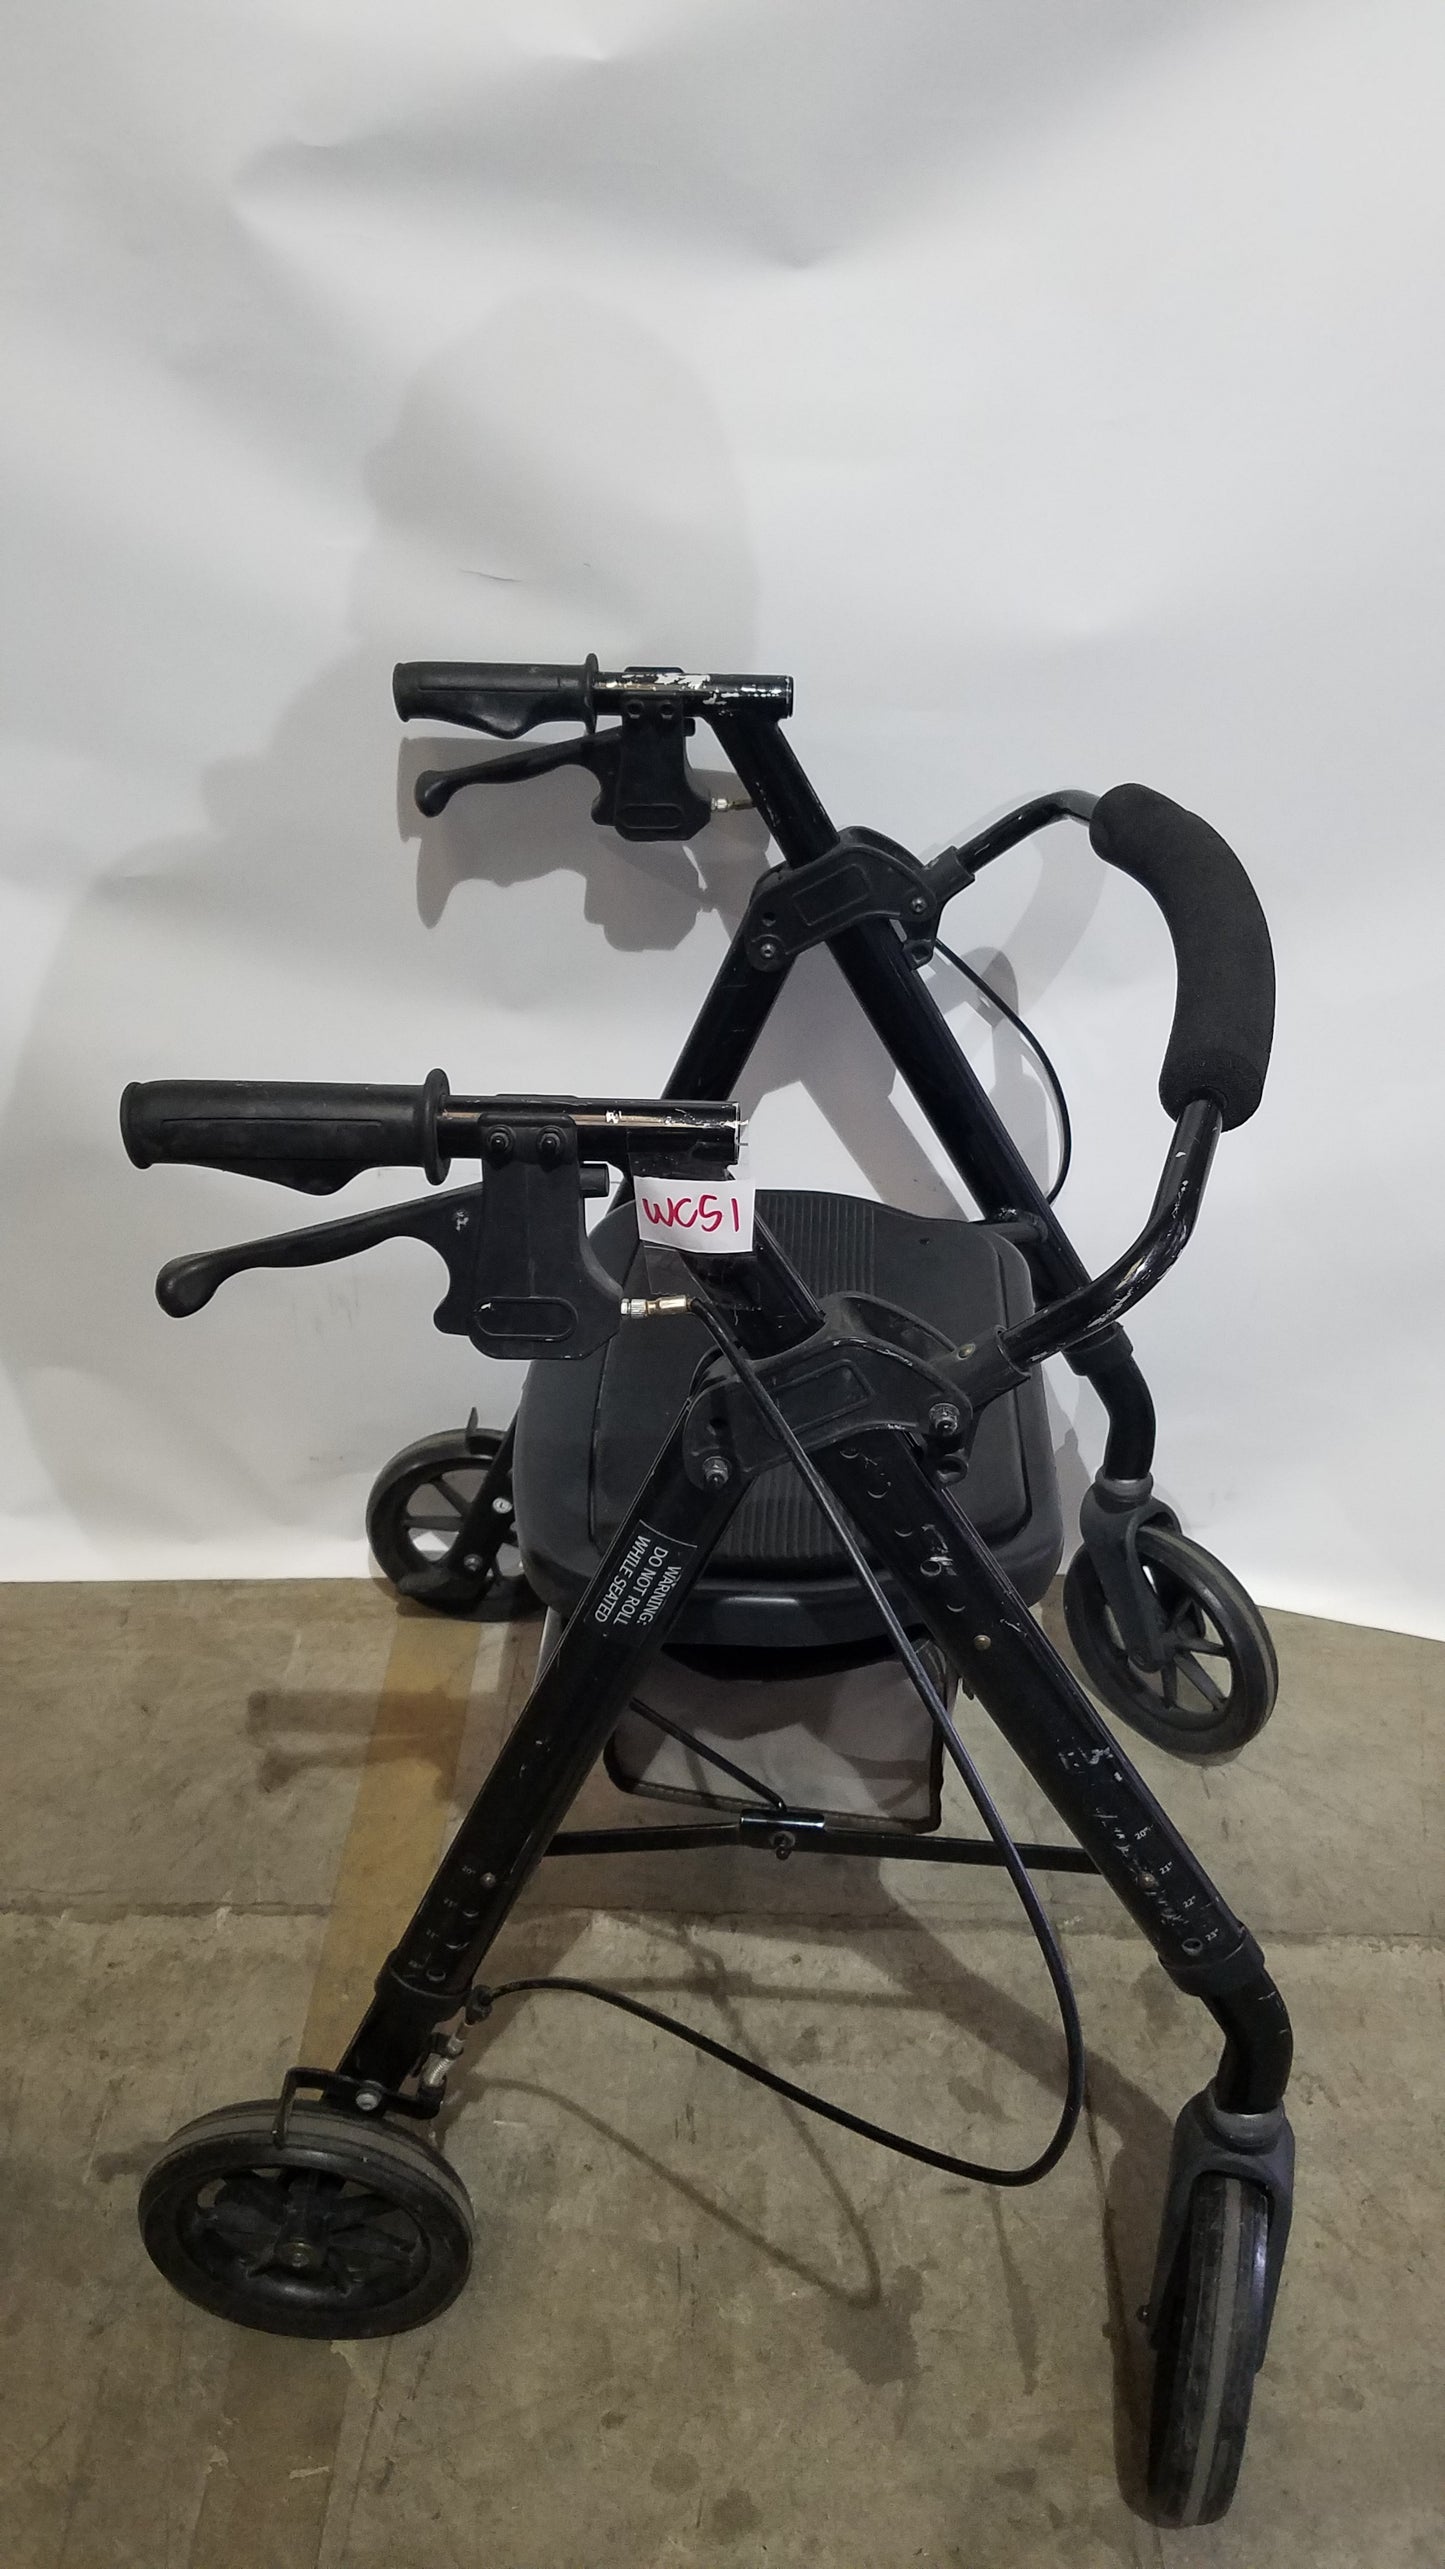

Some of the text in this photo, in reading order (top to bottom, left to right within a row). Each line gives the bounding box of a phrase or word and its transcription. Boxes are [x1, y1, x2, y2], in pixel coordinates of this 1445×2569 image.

[641, 1194, 740, 1233] WC51
[594, 1535, 651, 1622] WHILE SEATED
[613, 1546, 669, 1625] DO NOT ROLL
[637, 1566, 682, 1626] WARNING:
